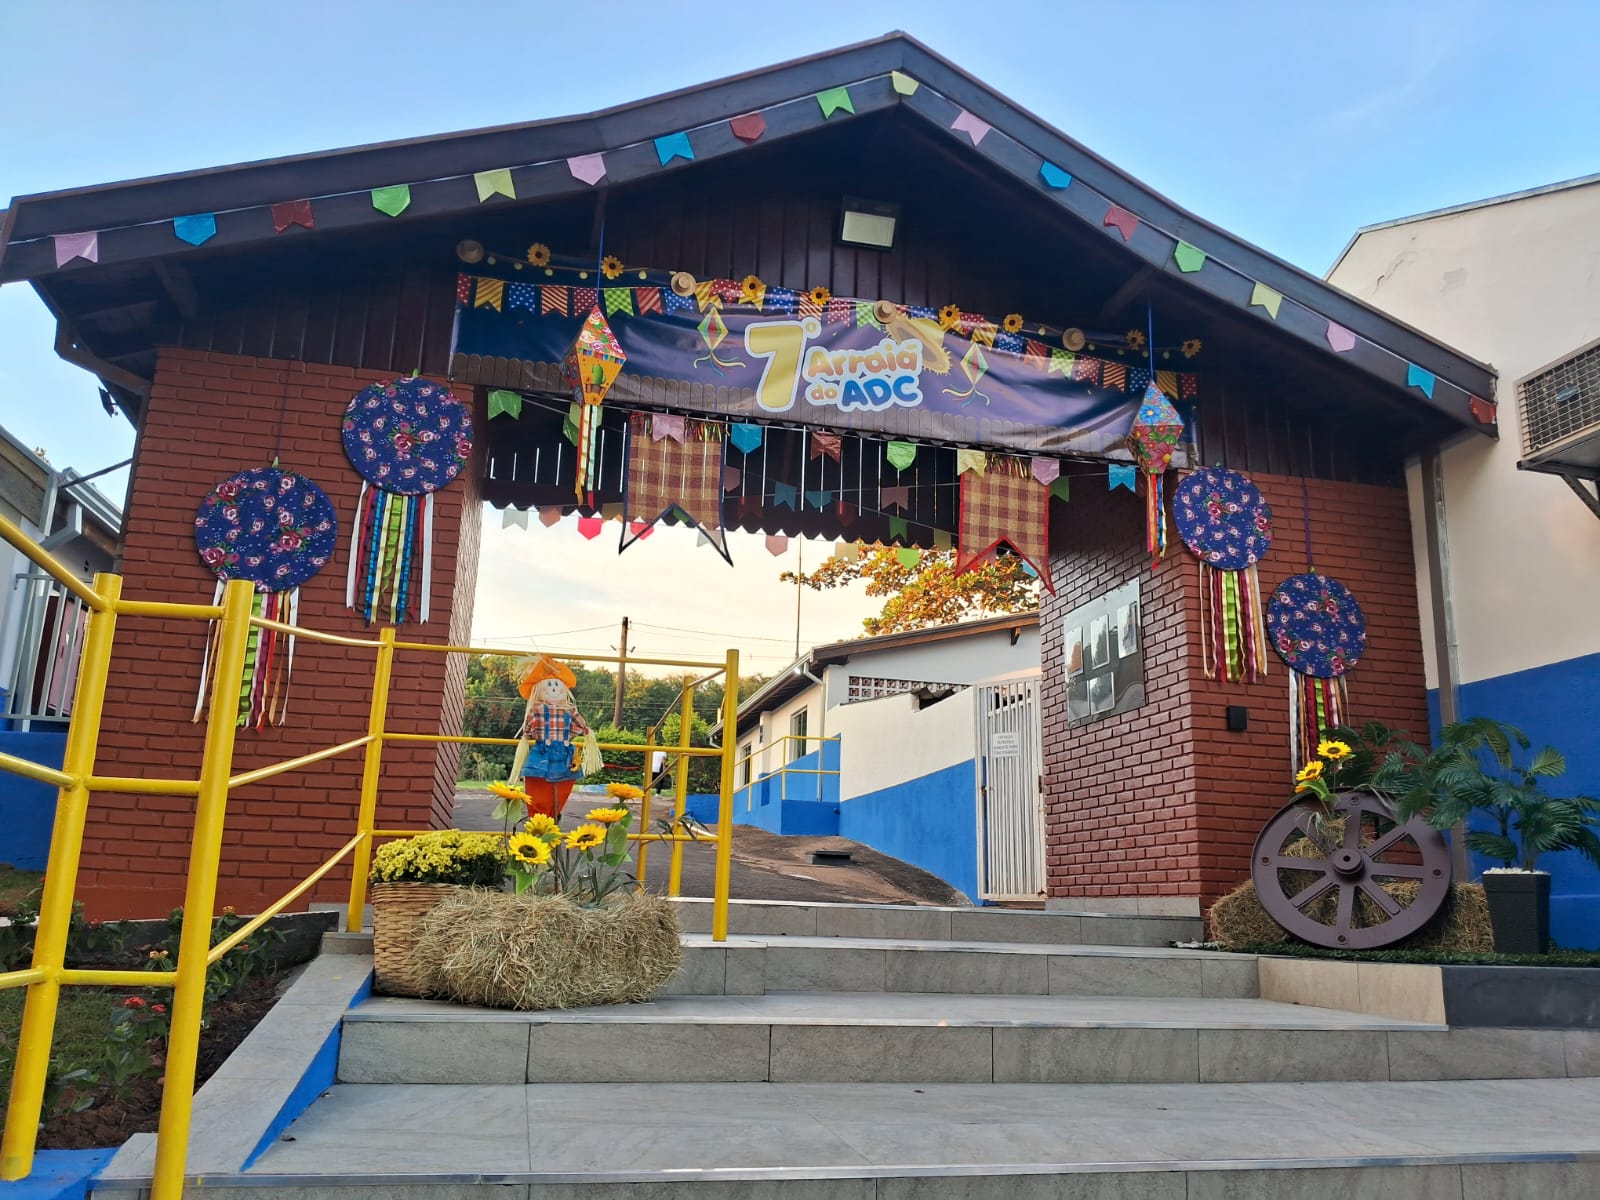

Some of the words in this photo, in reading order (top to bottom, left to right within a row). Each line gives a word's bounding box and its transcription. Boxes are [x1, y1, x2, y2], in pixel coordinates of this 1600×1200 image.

[807, 342, 918, 378] Arraiá
[810, 384, 838, 401] do
[841, 374, 919, 407] ADC
